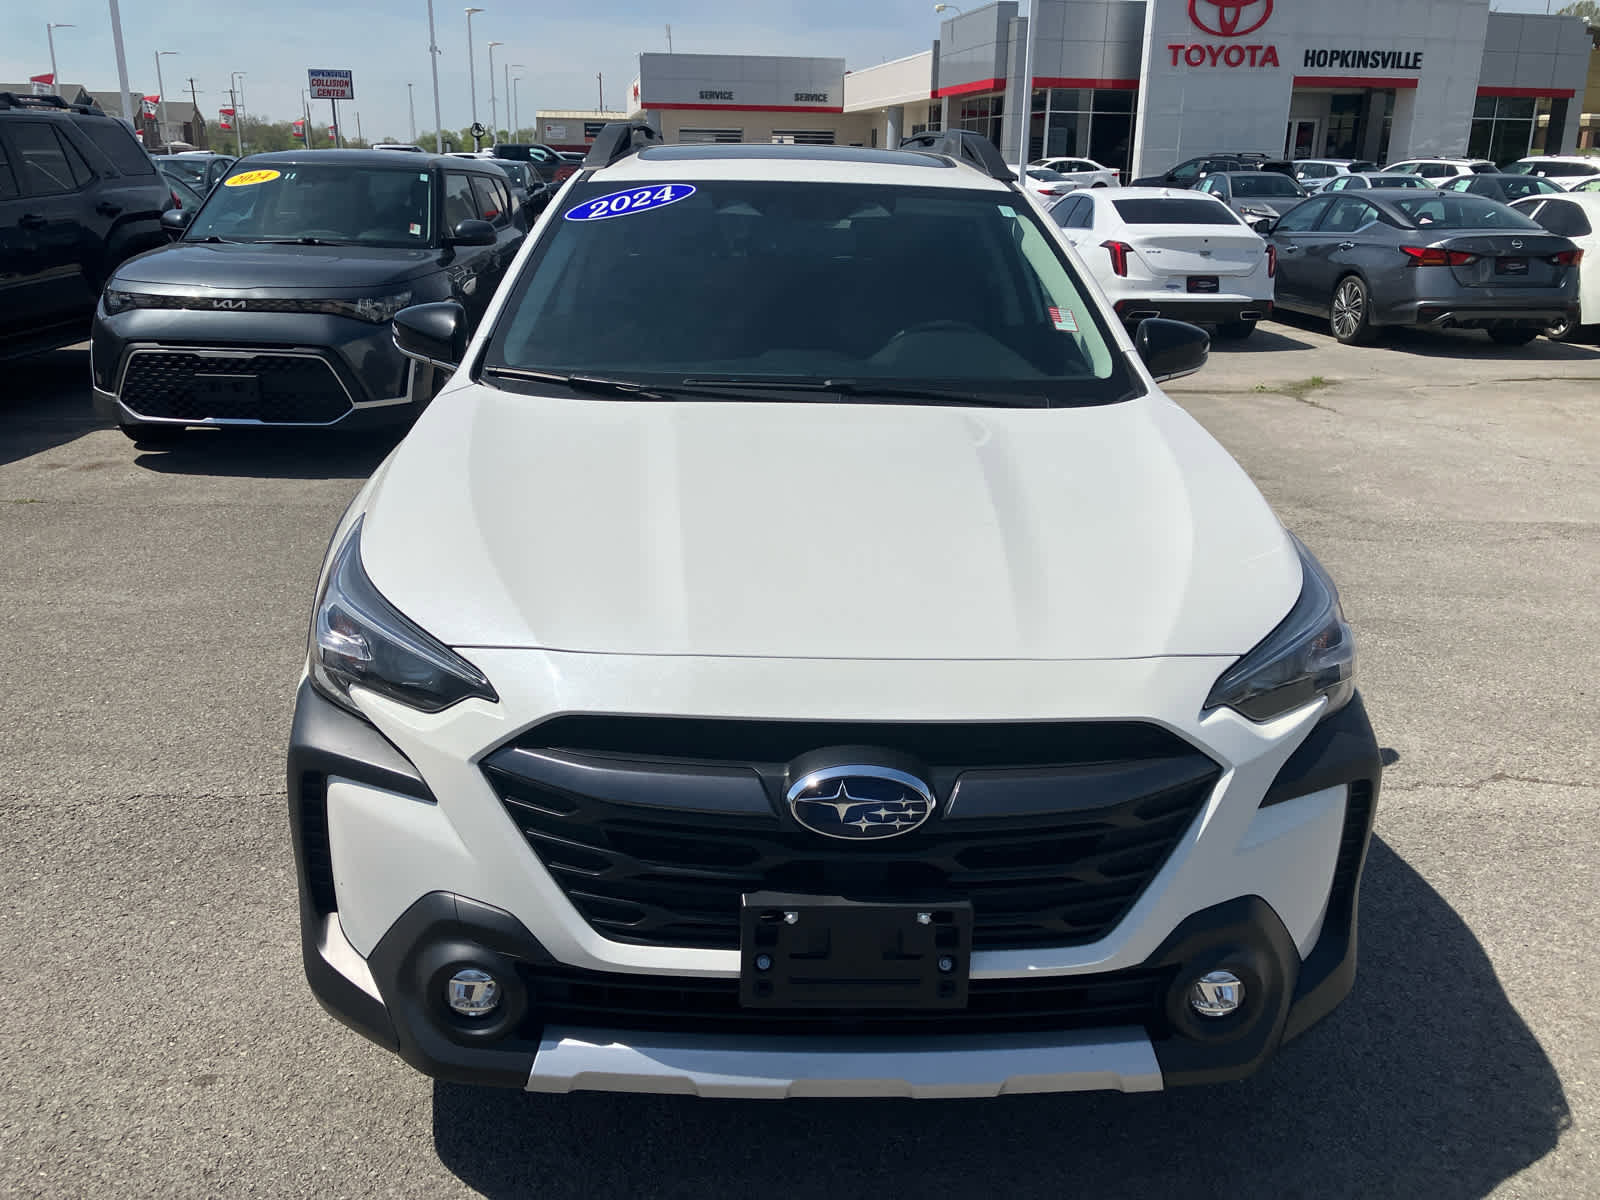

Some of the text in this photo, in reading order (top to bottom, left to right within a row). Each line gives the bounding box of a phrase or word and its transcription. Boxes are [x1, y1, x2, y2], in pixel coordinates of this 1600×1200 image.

[1168, 44, 1280, 68] TOYOTA
[1303, 49, 1424, 70] HOPKINSVILLE
[311, 78, 350, 88] COLLISION
[317, 88, 346, 97] CENTER
[699, 90, 735, 101] SERVICE
[794, 92, 829, 103] SERVICE
[588, 185, 676, 218] 2024
